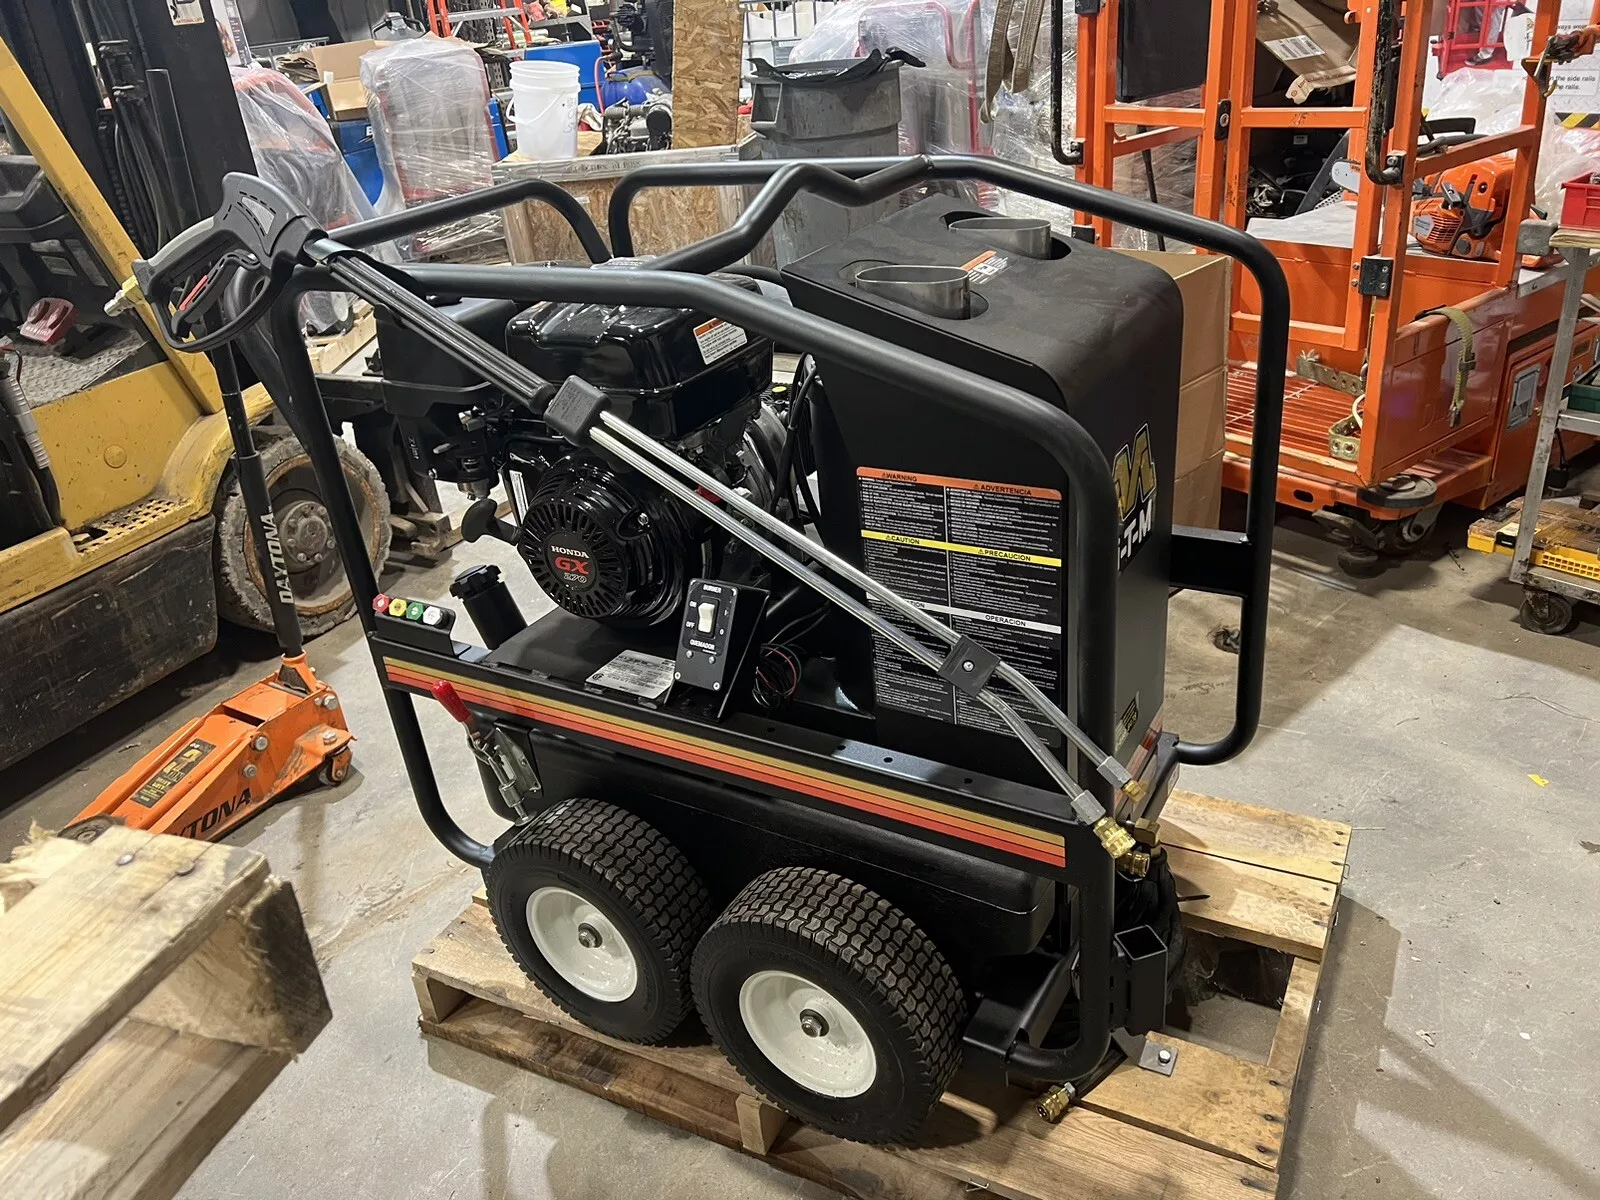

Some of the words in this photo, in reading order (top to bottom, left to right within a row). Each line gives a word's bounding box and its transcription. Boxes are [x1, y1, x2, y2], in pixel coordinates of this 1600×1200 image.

[886, 472, 918, 482] WARNING
[980, 484, 1032, 496] ADVERTENCIA
[891, 535, 920, 545] CAUTION
[260, 512, 294, 604] DAYTONA
[551, 545, 589, 559] HONDA
[984, 549, 1031, 562] PRECAUCION
[554, 556, 589, 575] GX
[563, 572, 587, 584] 270
[685, 620, 695, 628] OFF
[985, 614, 1026, 627] OPERACION
[689, 639, 715, 650] QUEMADOR
